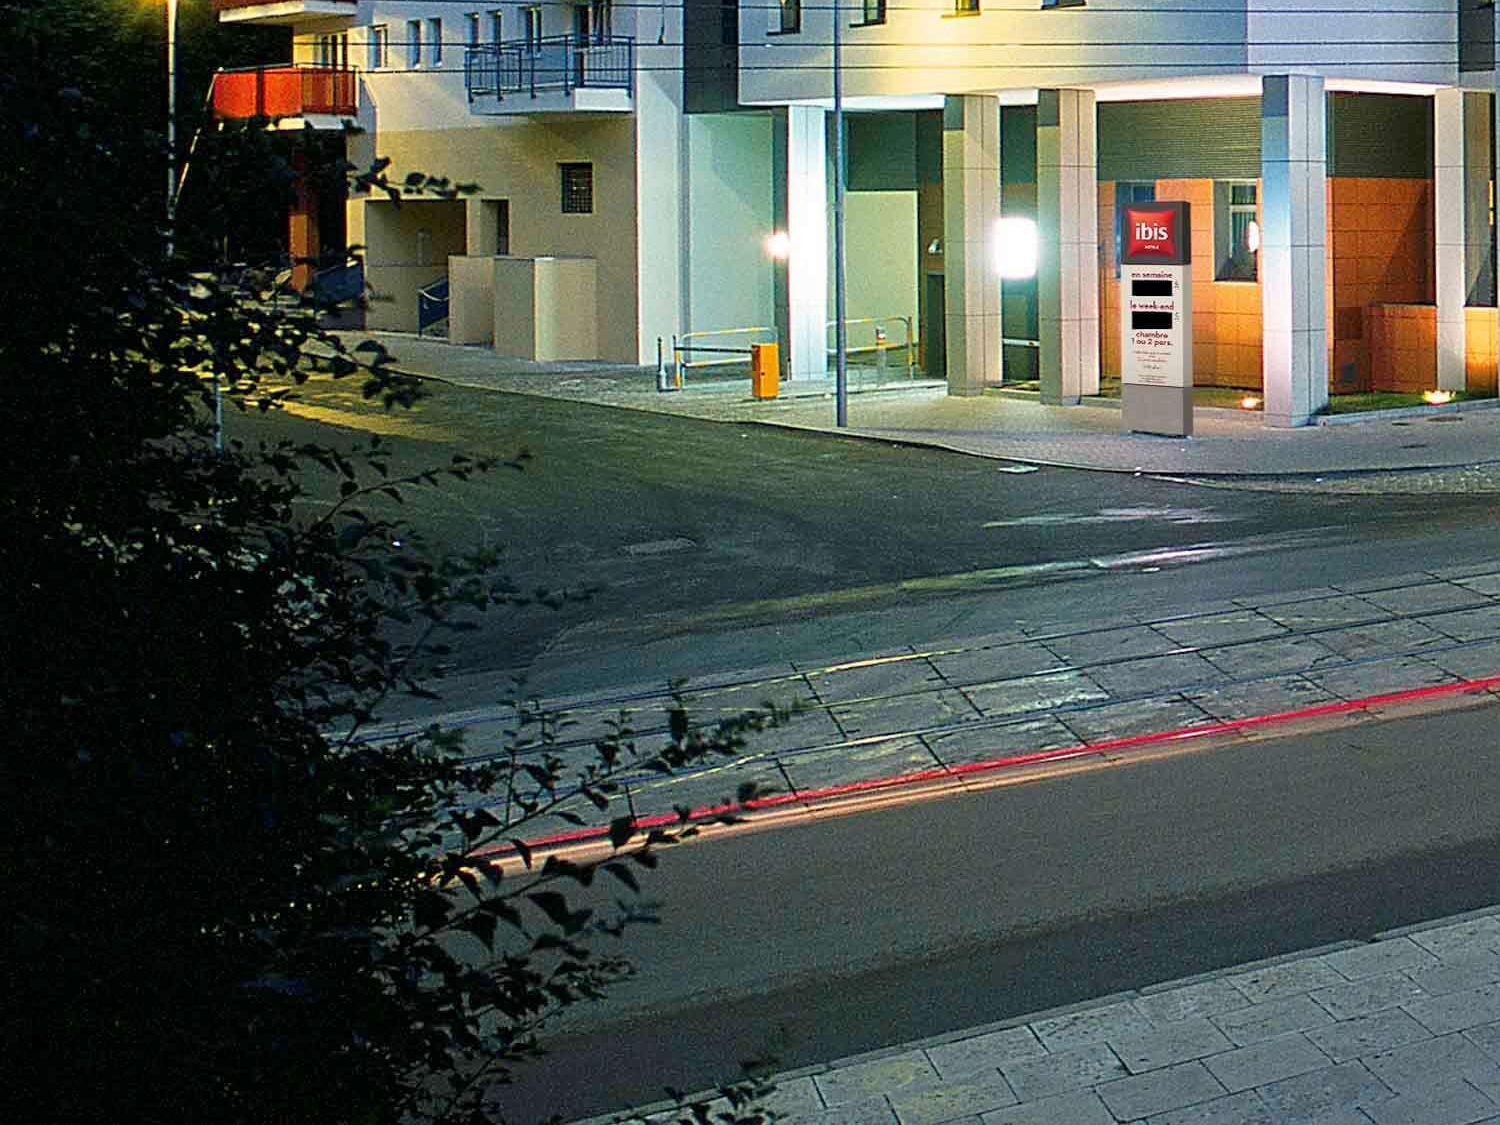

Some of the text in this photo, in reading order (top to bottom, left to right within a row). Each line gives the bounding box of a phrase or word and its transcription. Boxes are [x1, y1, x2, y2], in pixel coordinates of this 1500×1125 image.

[1135, 222, 1169, 240] ibis
[1129, 300, 1175, 310] le week-end
[1135, 331, 1169, 339] chambre
